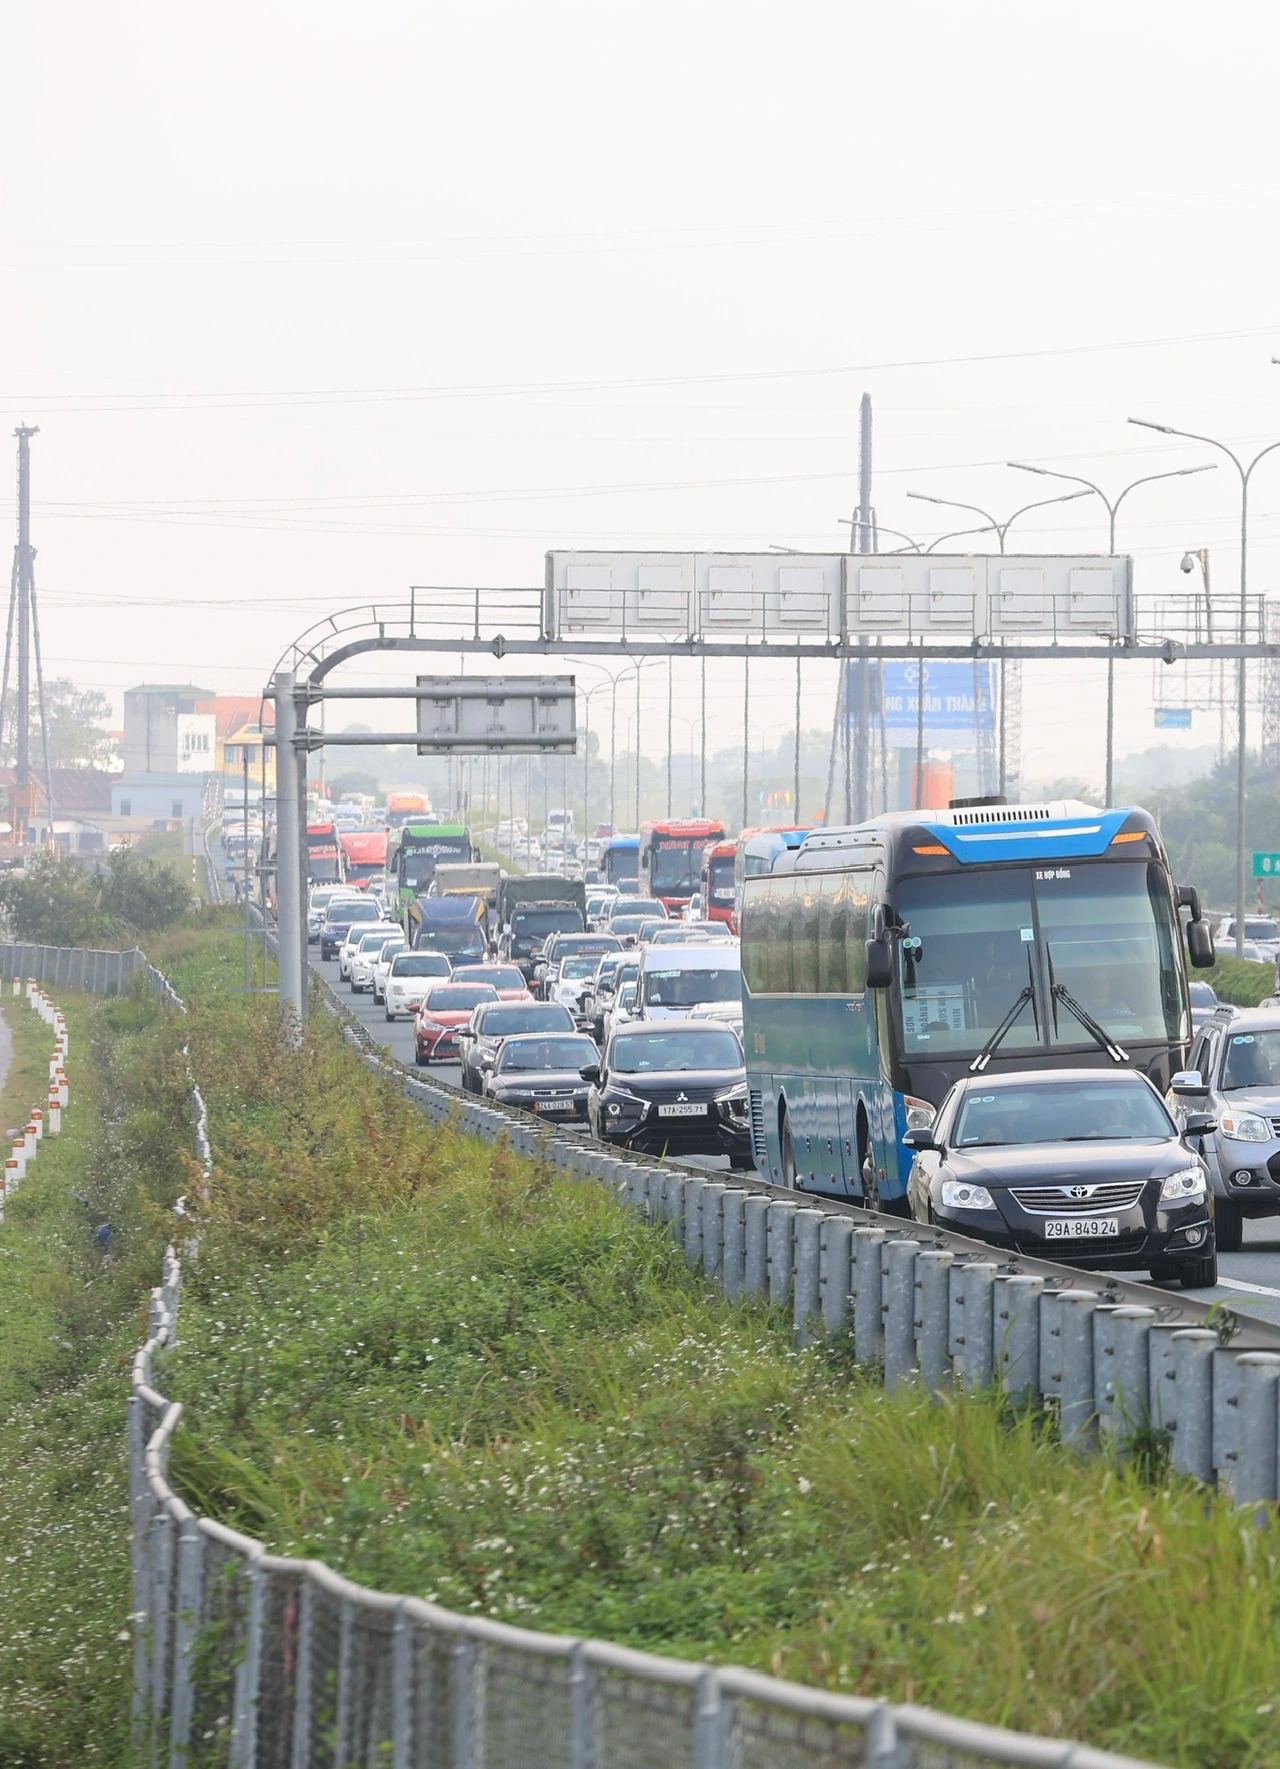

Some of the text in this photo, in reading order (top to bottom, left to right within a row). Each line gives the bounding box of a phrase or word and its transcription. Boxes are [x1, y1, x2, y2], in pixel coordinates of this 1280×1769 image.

[1035, 871, 1044, 880] XE
[663, 1106, 703, 1115] 17A-255.71
[1047, 1221, 1116, 1237] 29A-849.24
